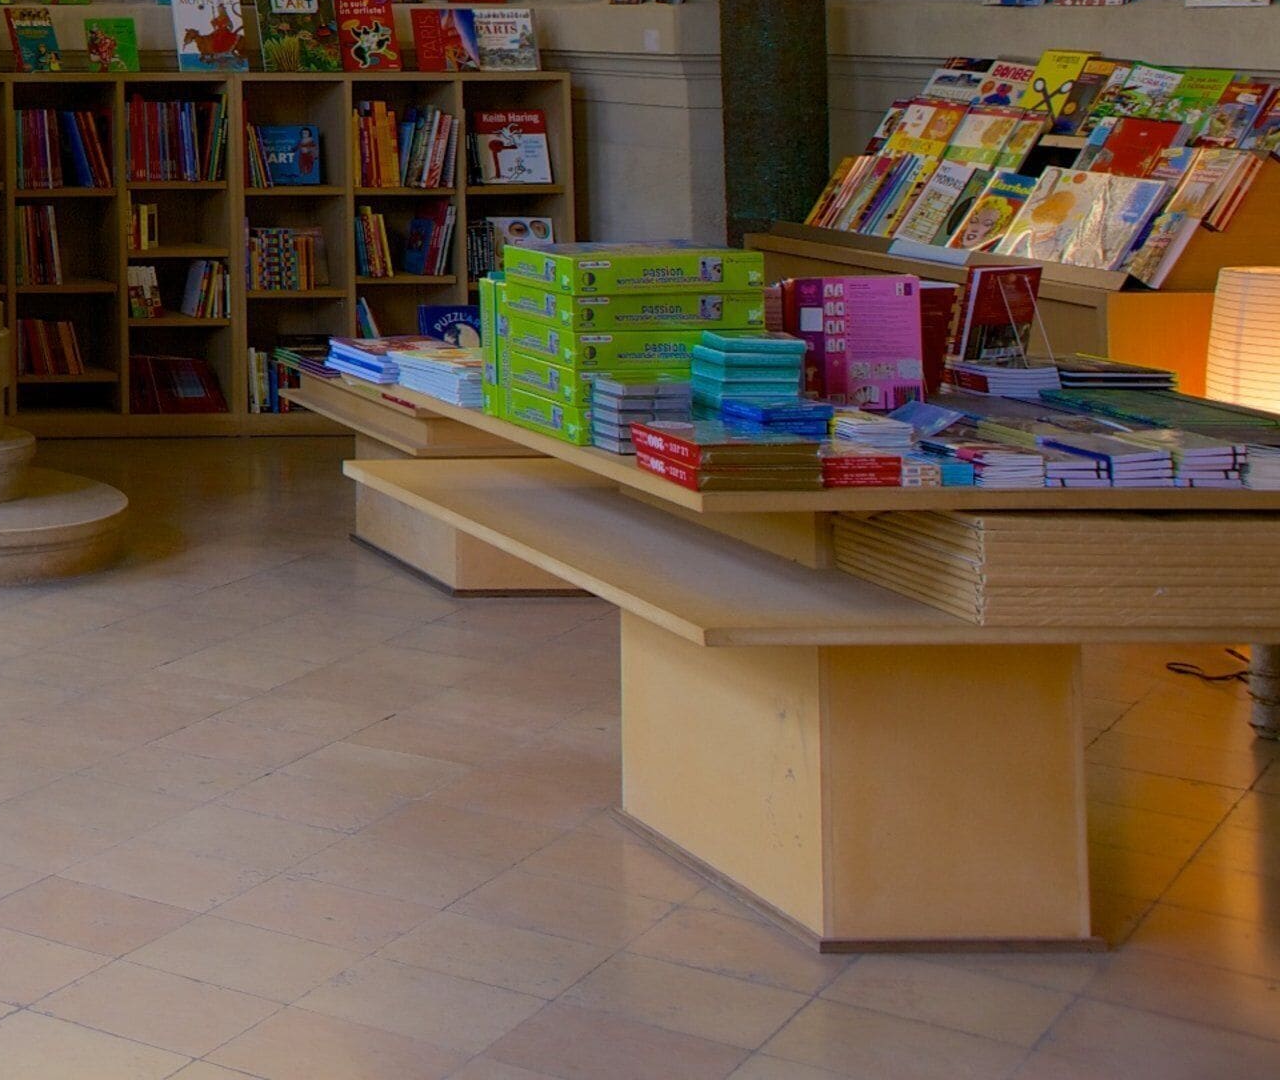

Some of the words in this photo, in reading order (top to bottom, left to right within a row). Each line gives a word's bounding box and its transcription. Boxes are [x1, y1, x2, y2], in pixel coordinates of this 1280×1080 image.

[475, 24, 518, 35] PARIS
[482, 113, 507, 123] Keith
[507, 112, 540, 124] Haring
[642, 266, 684, 279] passion
[640, 304, 682, 316] passion
[643, 342, 687, 354] passion
